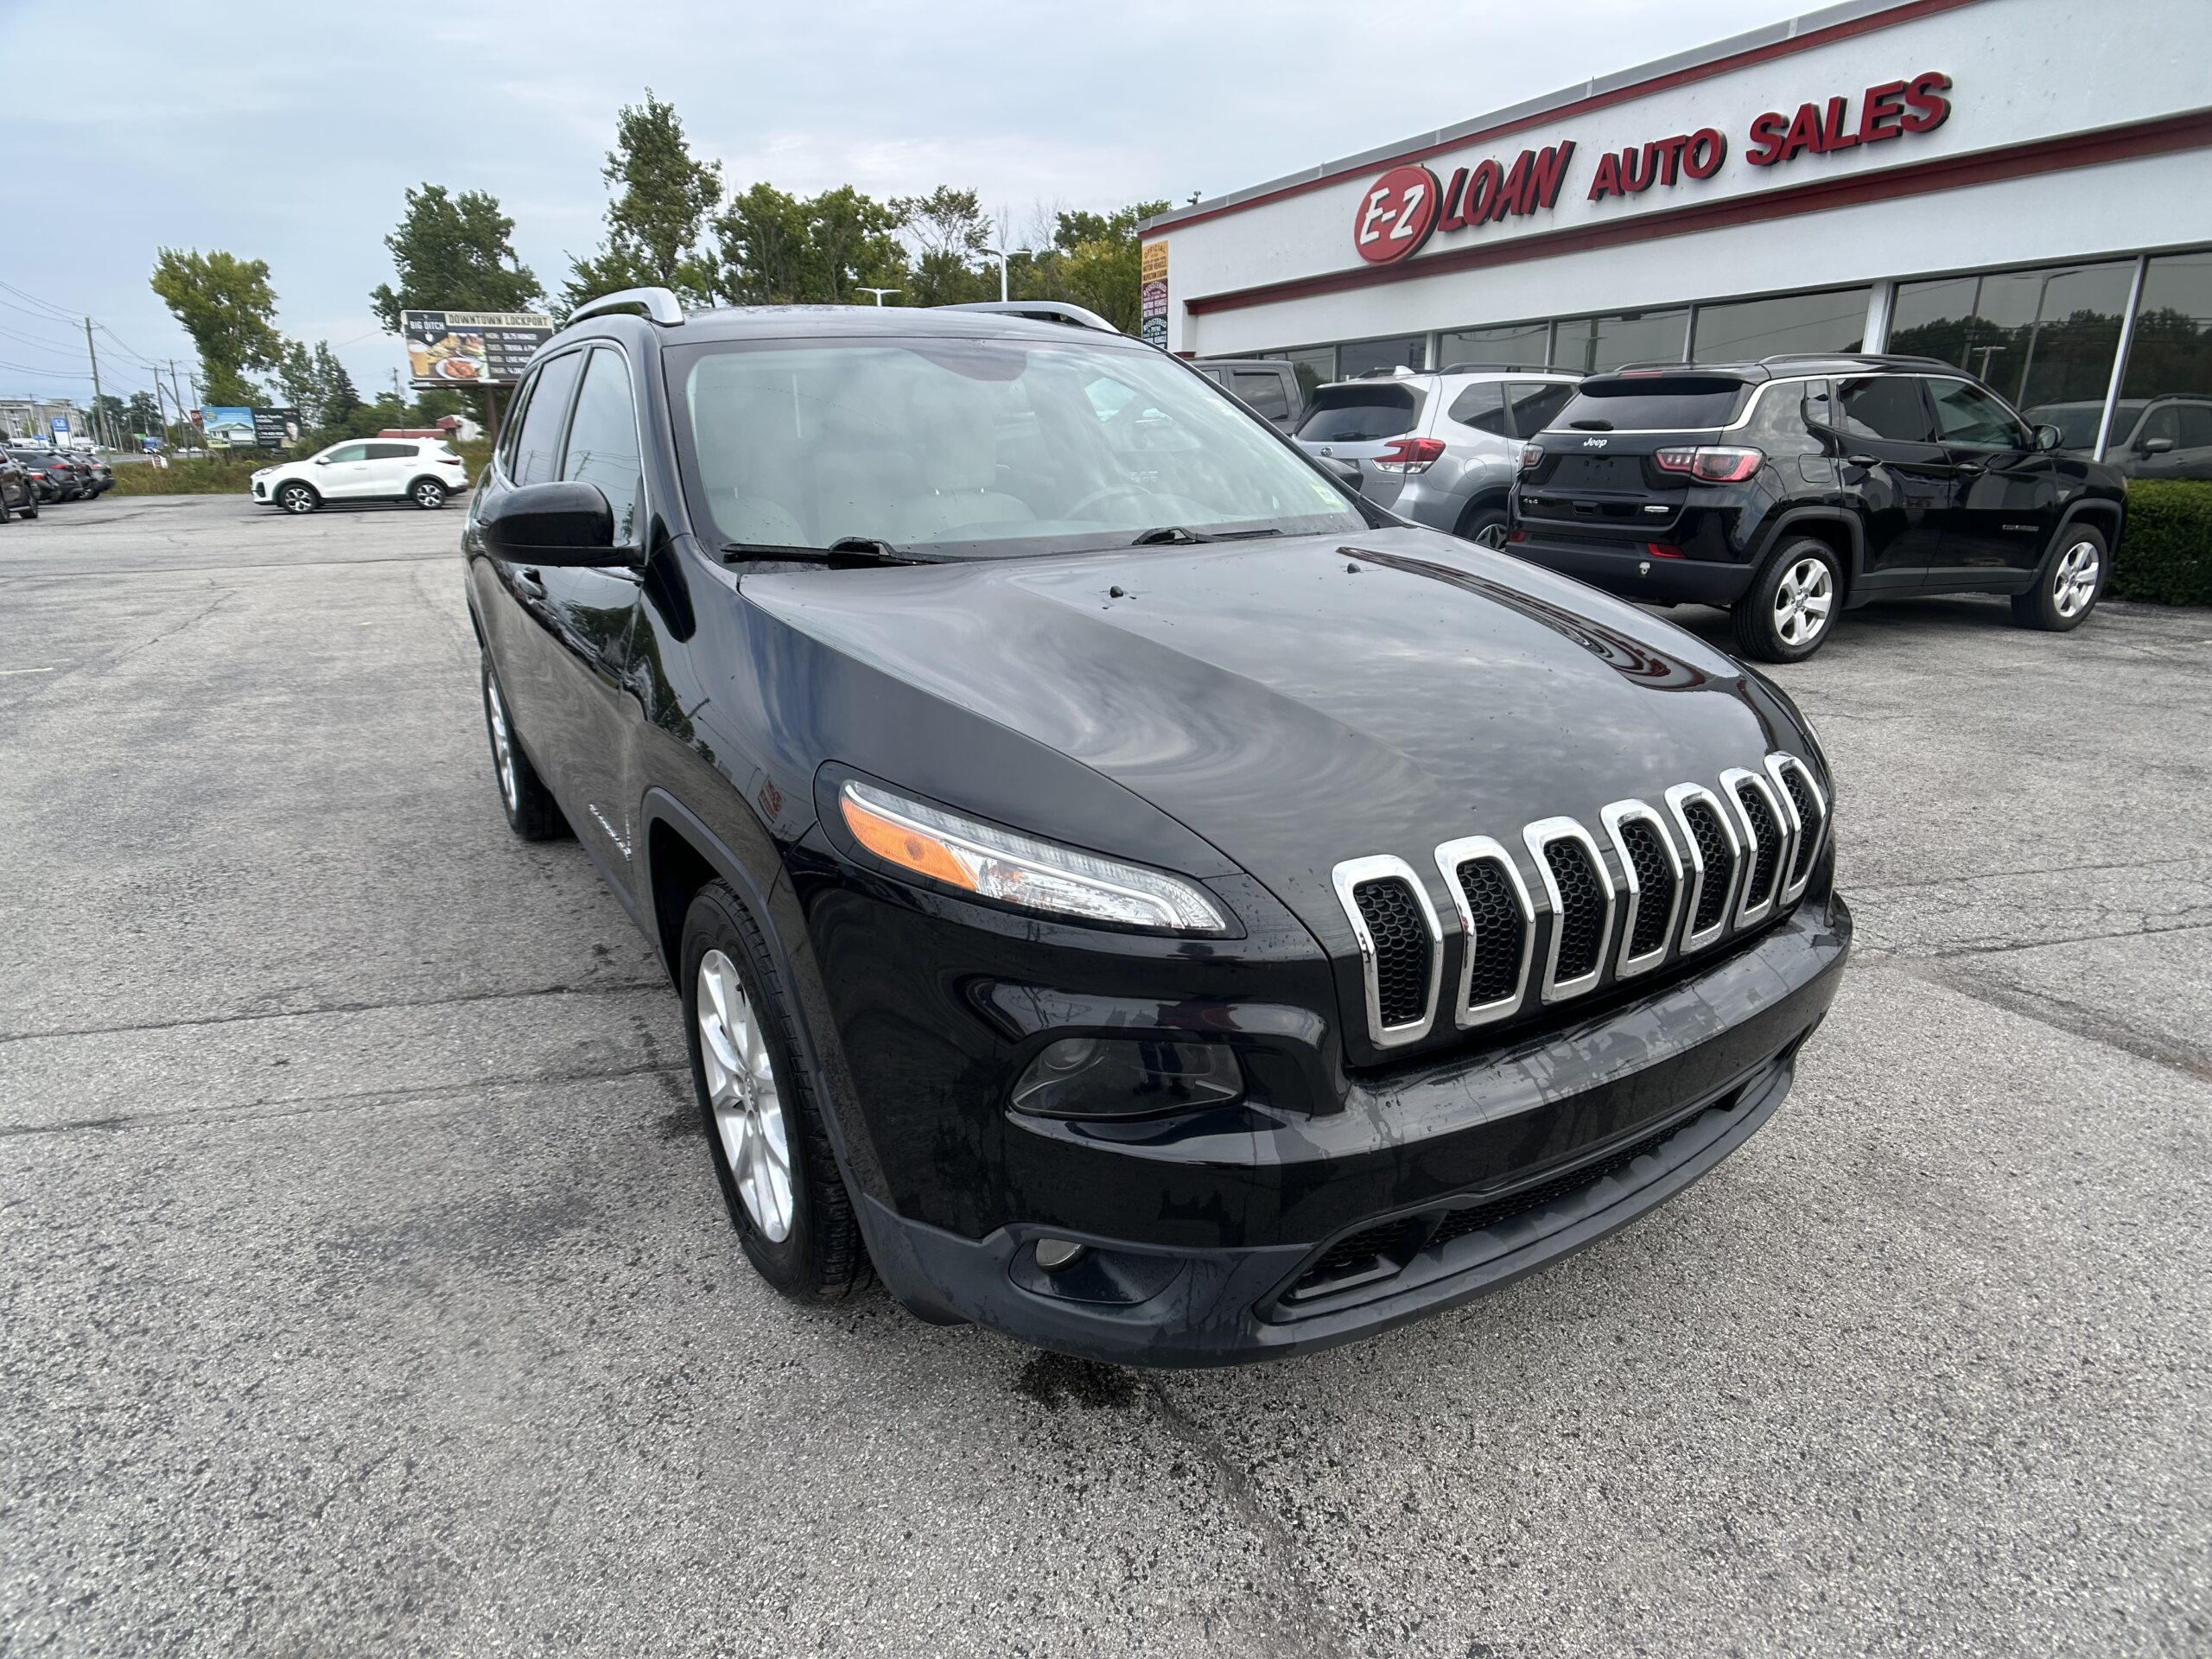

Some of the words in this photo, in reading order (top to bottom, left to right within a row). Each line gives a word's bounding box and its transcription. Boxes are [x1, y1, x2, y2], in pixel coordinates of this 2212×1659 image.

[1360, 184, 1424, 245] E-Z
[1437, 140, 1577, 232] LOAN
[1587, 128, 1727, 200] AUTO
[1745, 72, 1953, 166] SALES
[410, 321, 423, 329] BIG
[423, 321, 445, 330] DITCH
[448, 314, 503, 325] DOWNTOWN
[505, 315, 548, 326] LOCKPORT
[1583, 436, 1608, 448] Jeep
